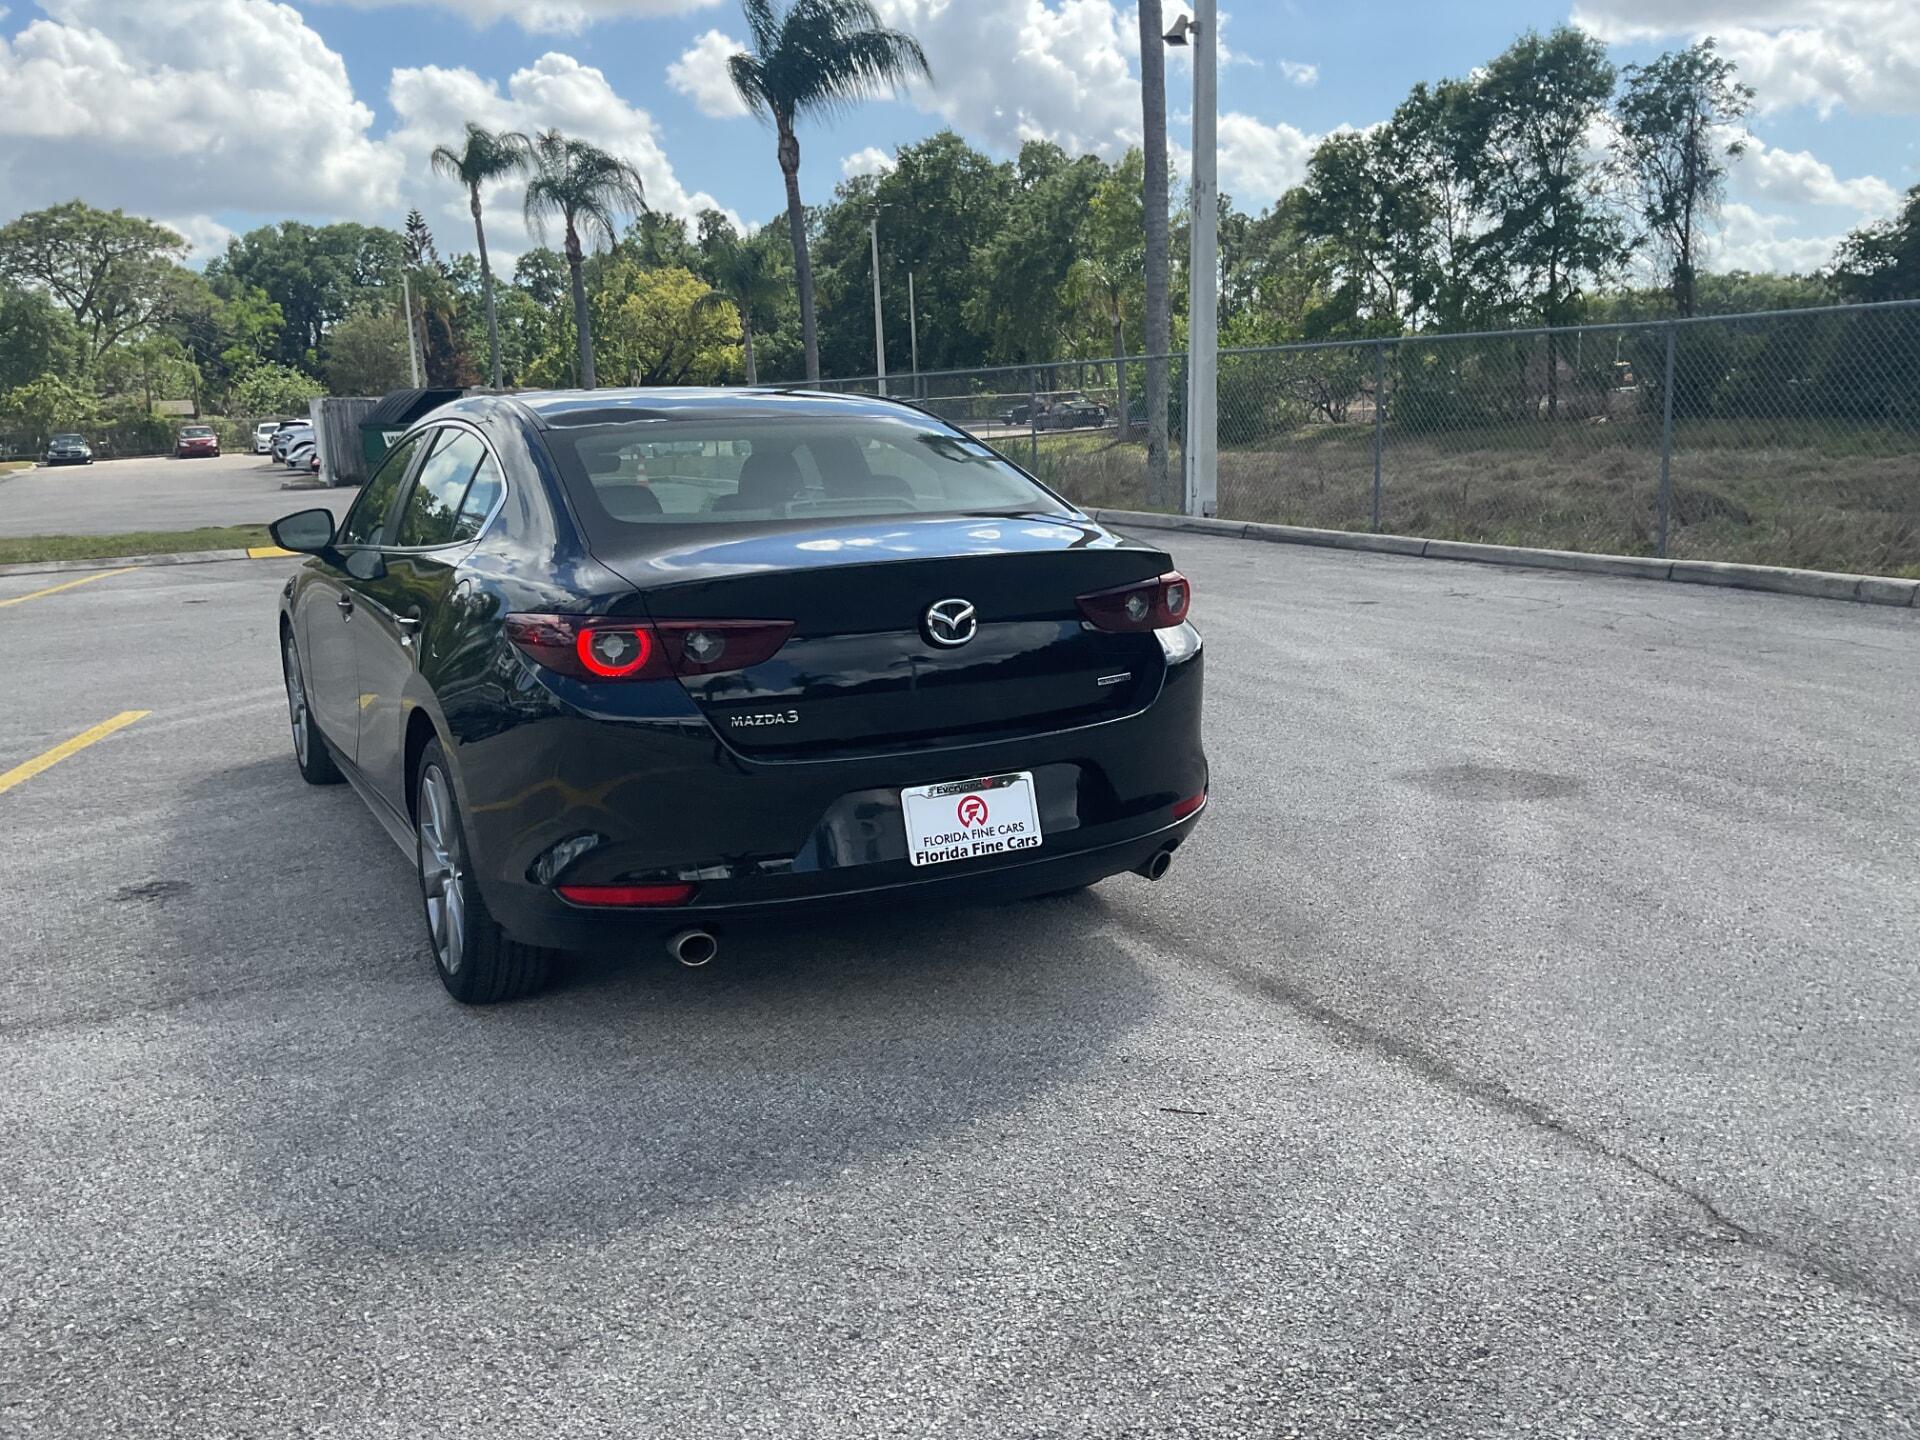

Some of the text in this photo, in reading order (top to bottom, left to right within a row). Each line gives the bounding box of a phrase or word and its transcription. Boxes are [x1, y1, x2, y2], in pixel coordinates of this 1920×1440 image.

[731, 710, 799, 728] MAZDA3
[923, 822, 1025, 847] FLORIDA FINE CARS
[916, 835, 1038, 865] Florida Fine Cars
